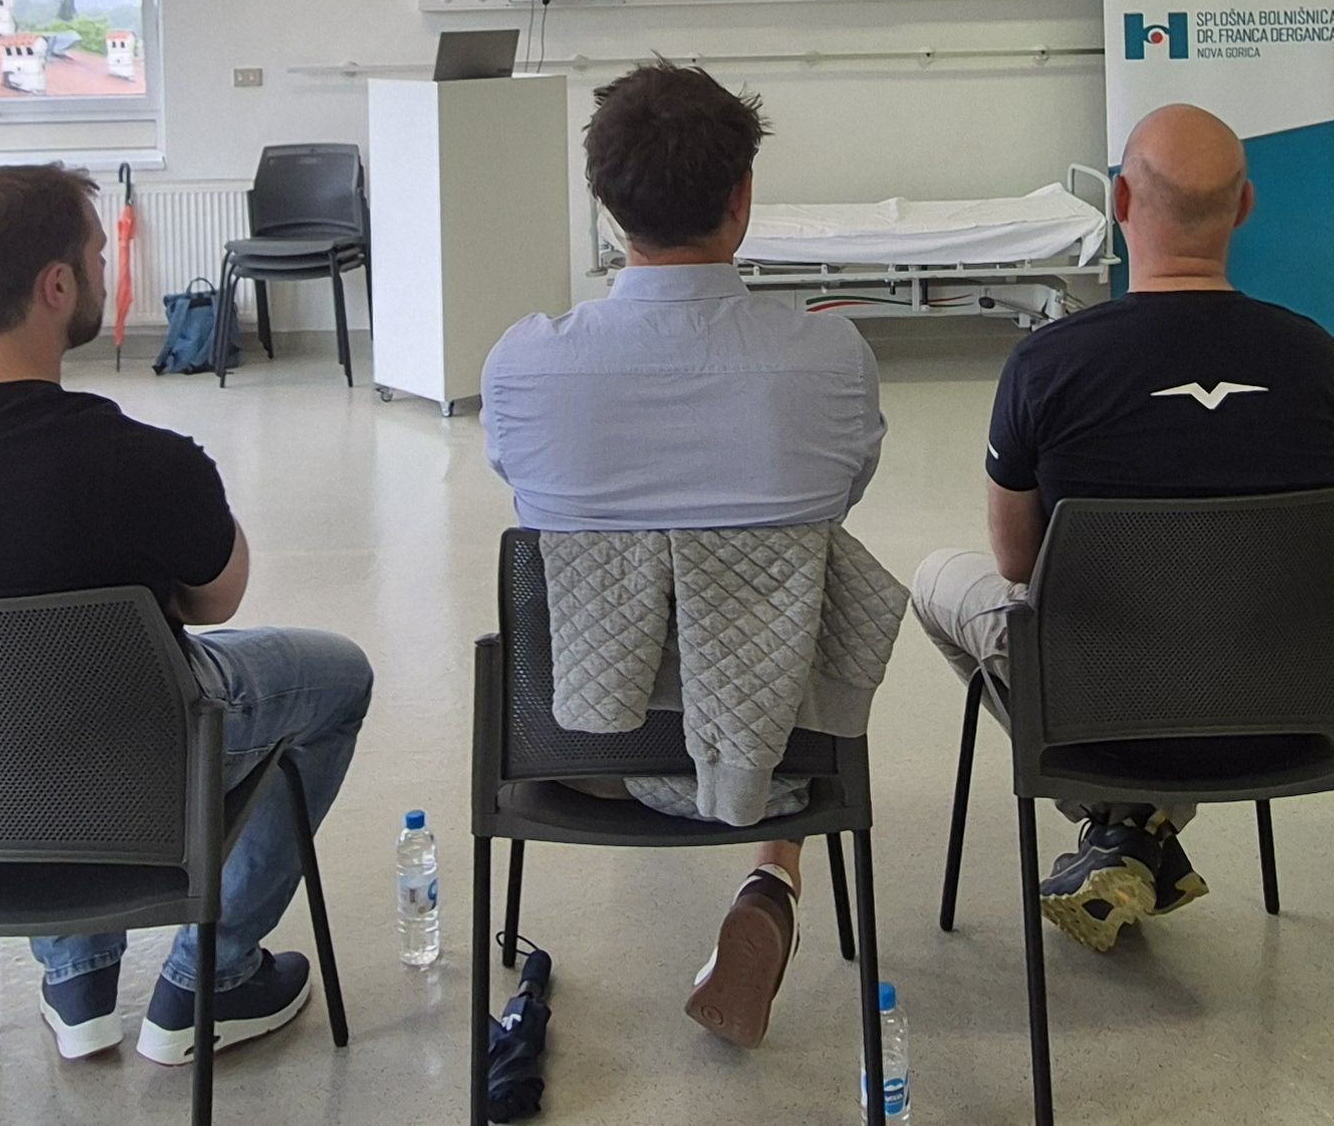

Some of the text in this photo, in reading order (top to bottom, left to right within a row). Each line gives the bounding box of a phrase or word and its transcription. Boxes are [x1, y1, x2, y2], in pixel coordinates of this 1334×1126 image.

[1196, 8, 1256, 26] SPLOŠNA
[1197, 28, 1217, 43] DR.
[1219, 27, 1269, 43] FRANCA
[1197, 46, 1261, 59] NOVA GORICA
